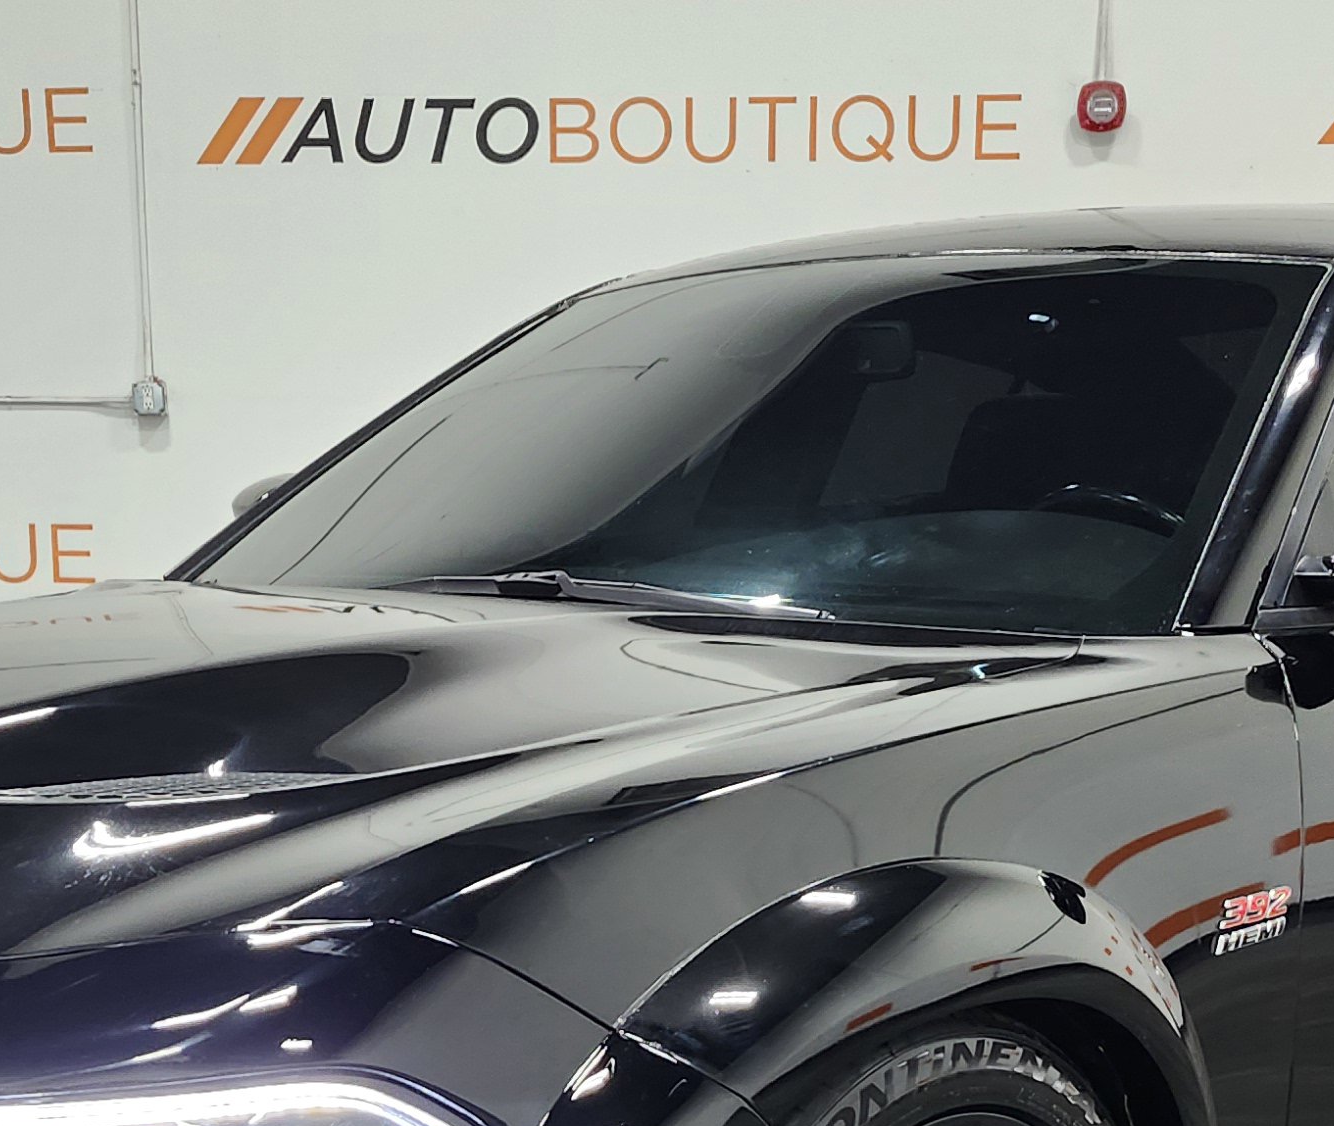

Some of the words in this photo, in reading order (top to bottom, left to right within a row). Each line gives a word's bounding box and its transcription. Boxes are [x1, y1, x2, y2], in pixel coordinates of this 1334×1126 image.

[281, 95, 1022, 164] AUTOBOUTIQUE
[1219, 886, 1292, 930] 392
[1214, 916, 1287, 956] HEMI
